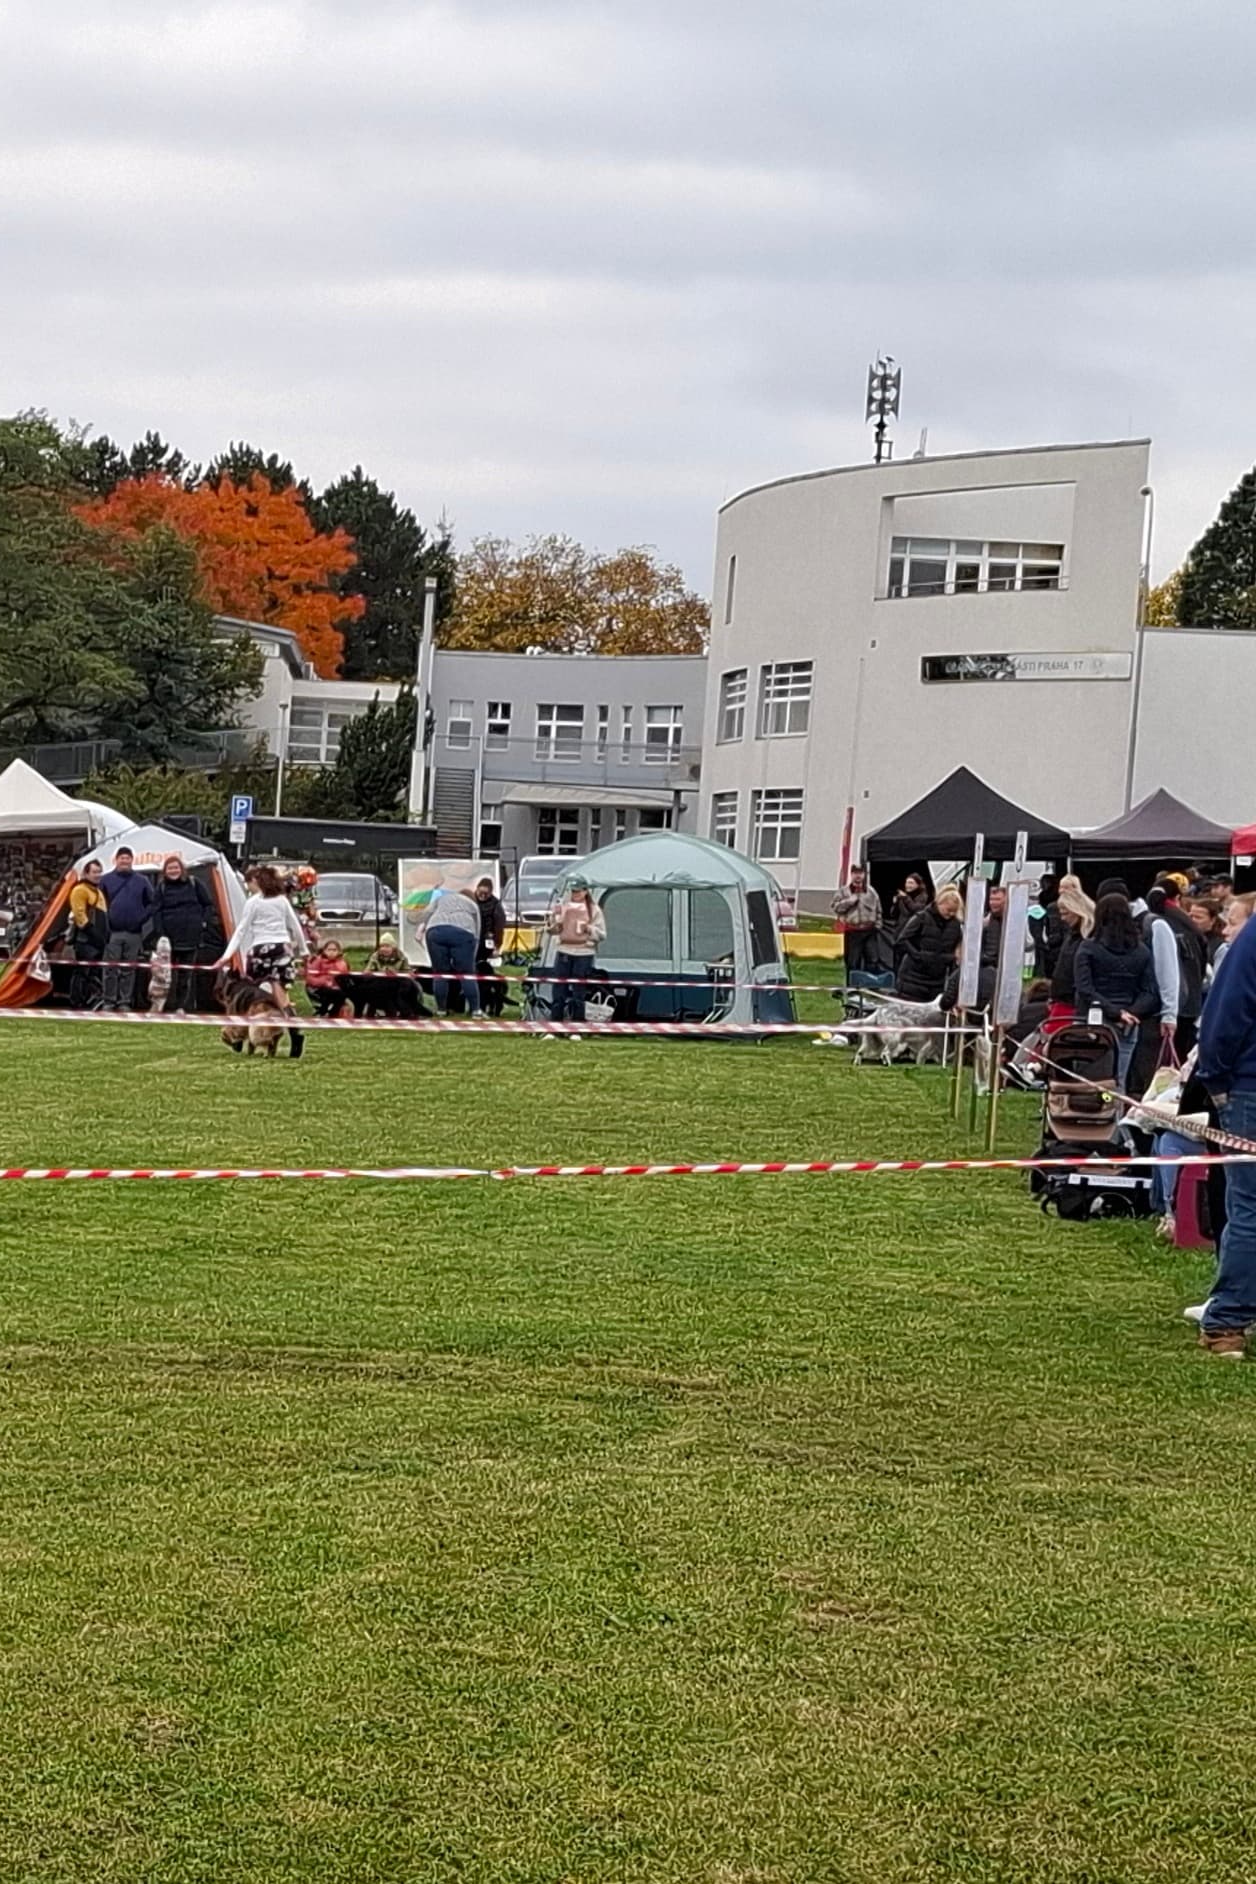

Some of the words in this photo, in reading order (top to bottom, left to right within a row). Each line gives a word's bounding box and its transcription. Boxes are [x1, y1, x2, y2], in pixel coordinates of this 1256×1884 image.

[1037, 660, 1070, 672] PRAHA
[1073, 660, 1084, 670] 17
[236, 799, 248, 815] P
